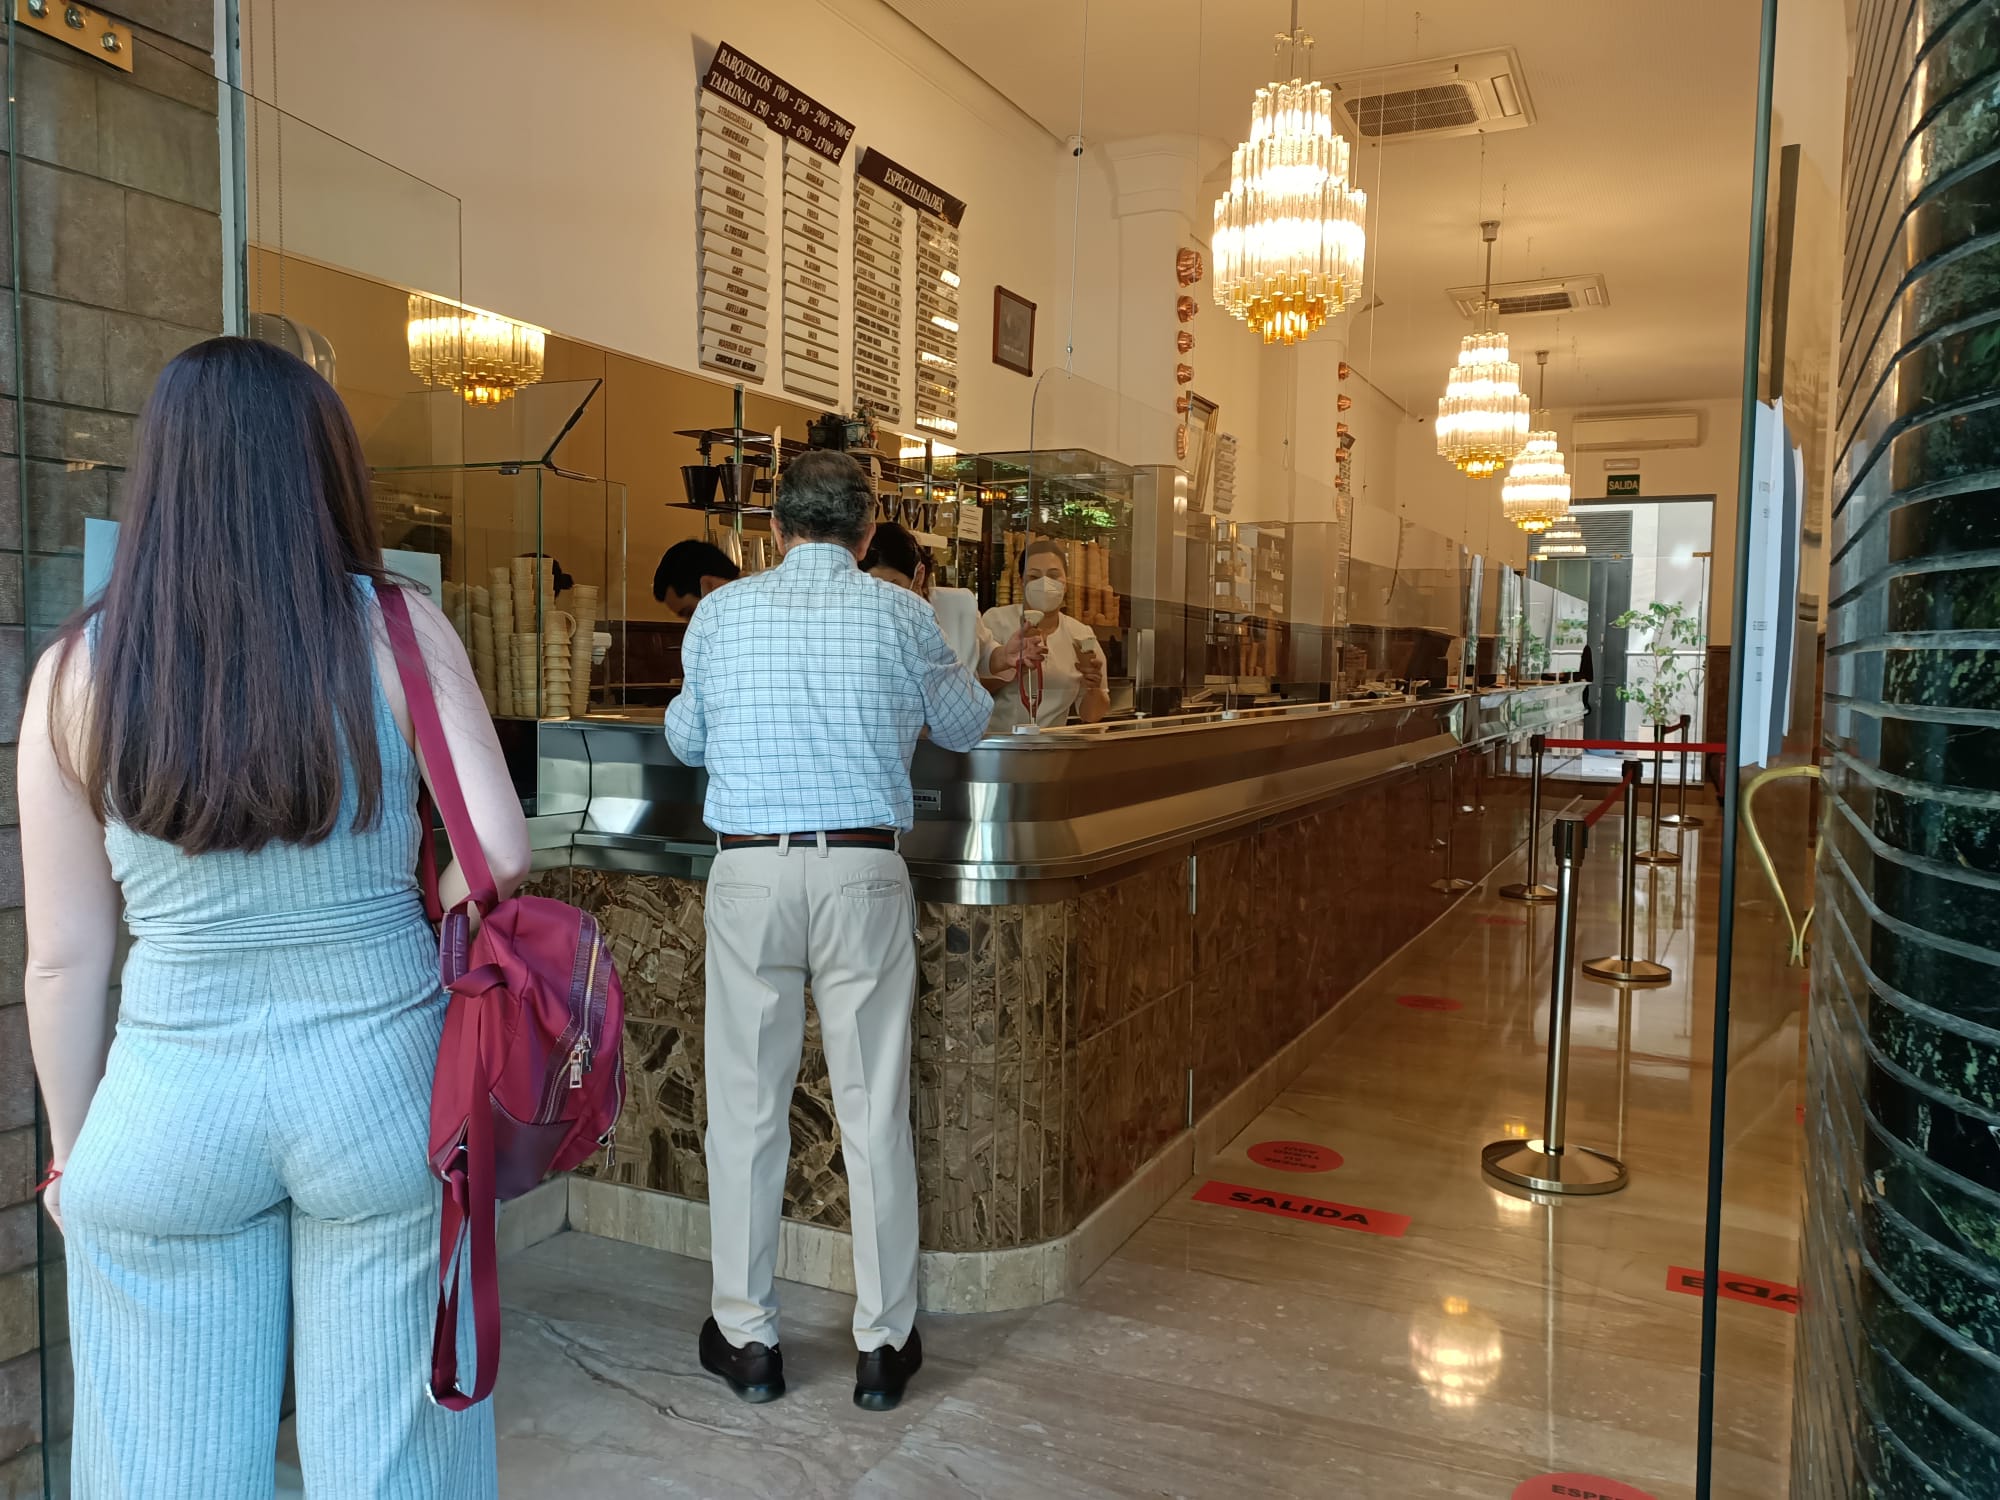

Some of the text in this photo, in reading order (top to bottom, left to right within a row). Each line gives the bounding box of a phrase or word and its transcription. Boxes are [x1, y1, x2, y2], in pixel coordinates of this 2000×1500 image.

[718, 49, 772, 92] BARQUILLOS
[709, 72, 753, 107] TARRINAS
[721, 126, 750, 147] CHOCOLATE
[883, 167, 945, 213] ESPECIALIDADES
[1609, 480, 1638, 490] SALIDA
[1228, 1190, 1370, 1226] SALIDA
